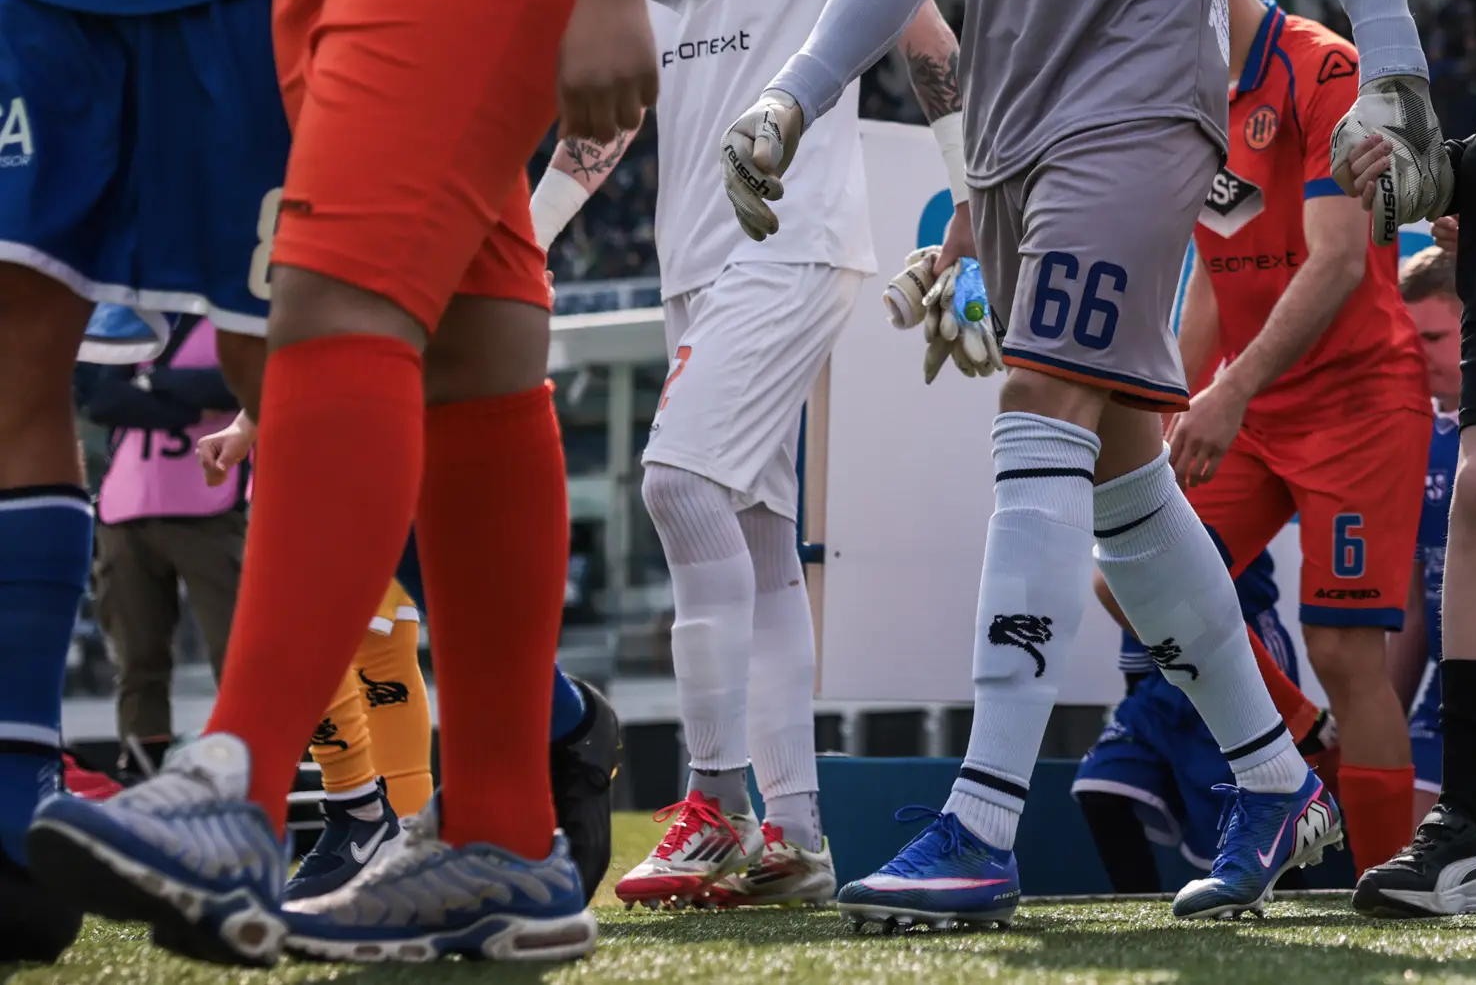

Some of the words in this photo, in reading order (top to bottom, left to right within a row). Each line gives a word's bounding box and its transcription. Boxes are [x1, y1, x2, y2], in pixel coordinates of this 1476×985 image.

[724, 144, 771, 196] reusch
[1207, 173, 1239, 205] SF
[1030, 251, 1128, 350] 66
[1332, 513, 1366, 579] 6
